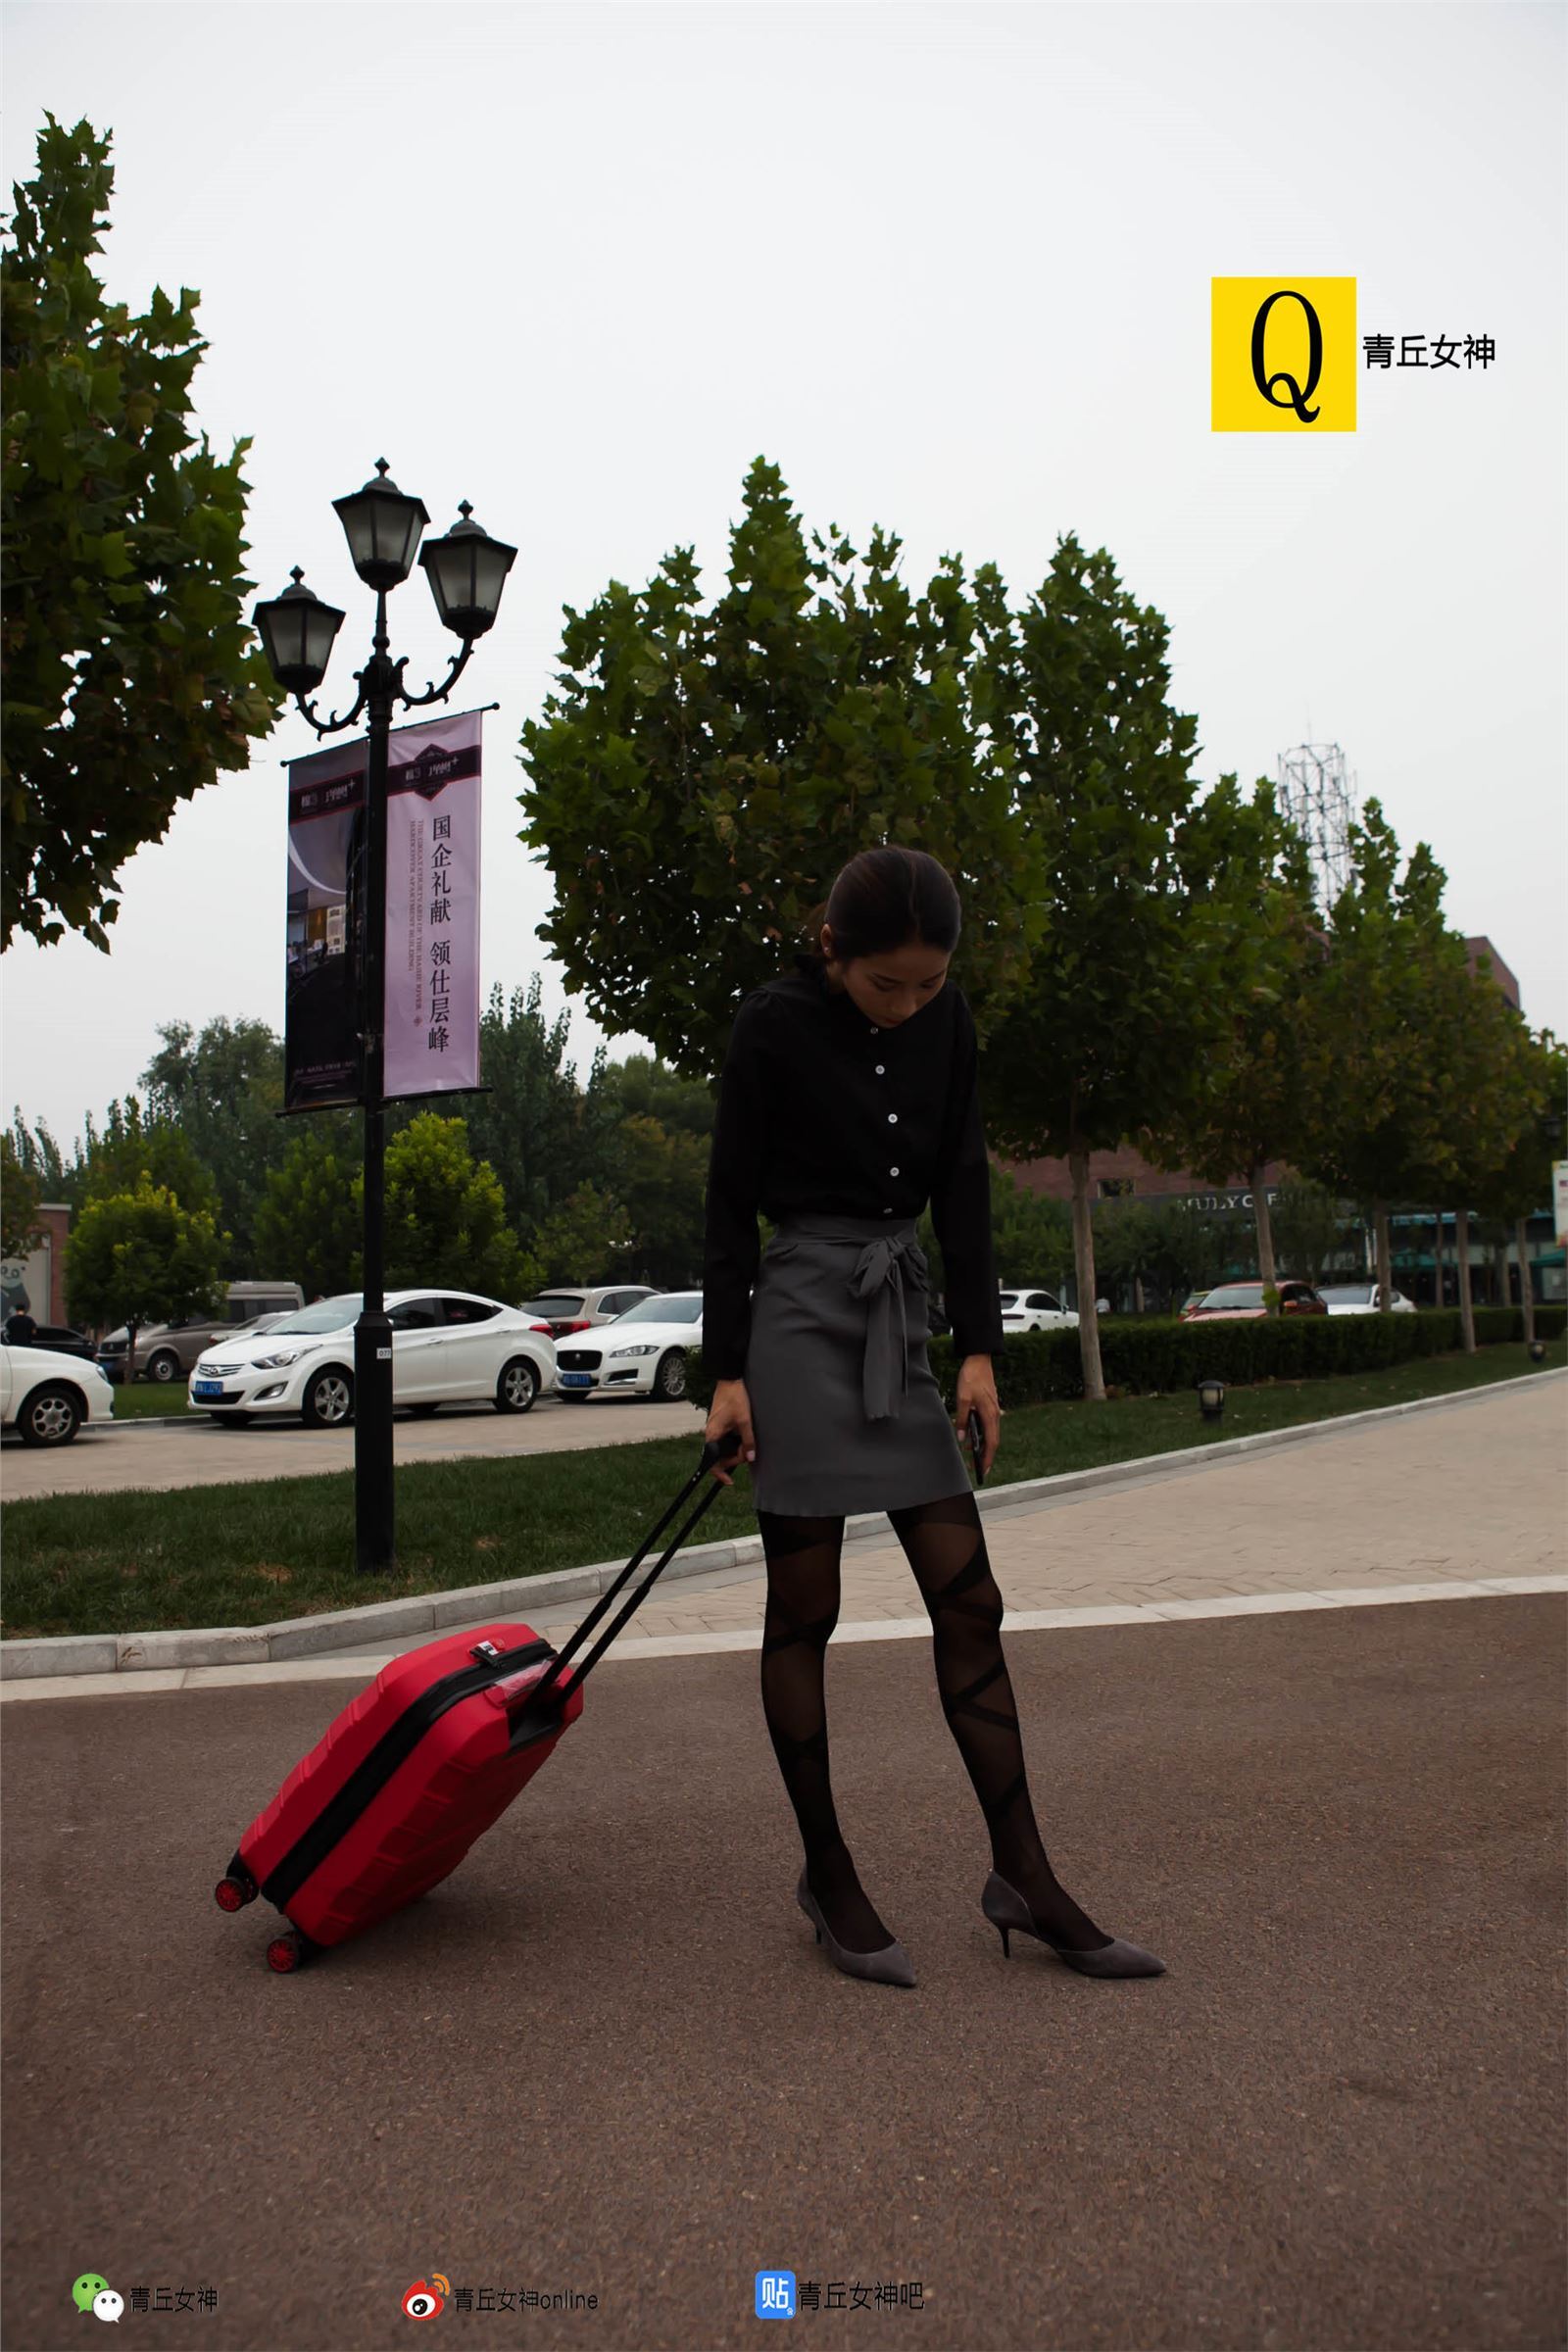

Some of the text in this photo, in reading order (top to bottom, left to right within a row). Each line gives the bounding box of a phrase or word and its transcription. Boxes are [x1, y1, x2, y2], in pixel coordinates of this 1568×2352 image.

[428, 815, 453, 1053] 国企礼献 领仕层峰
